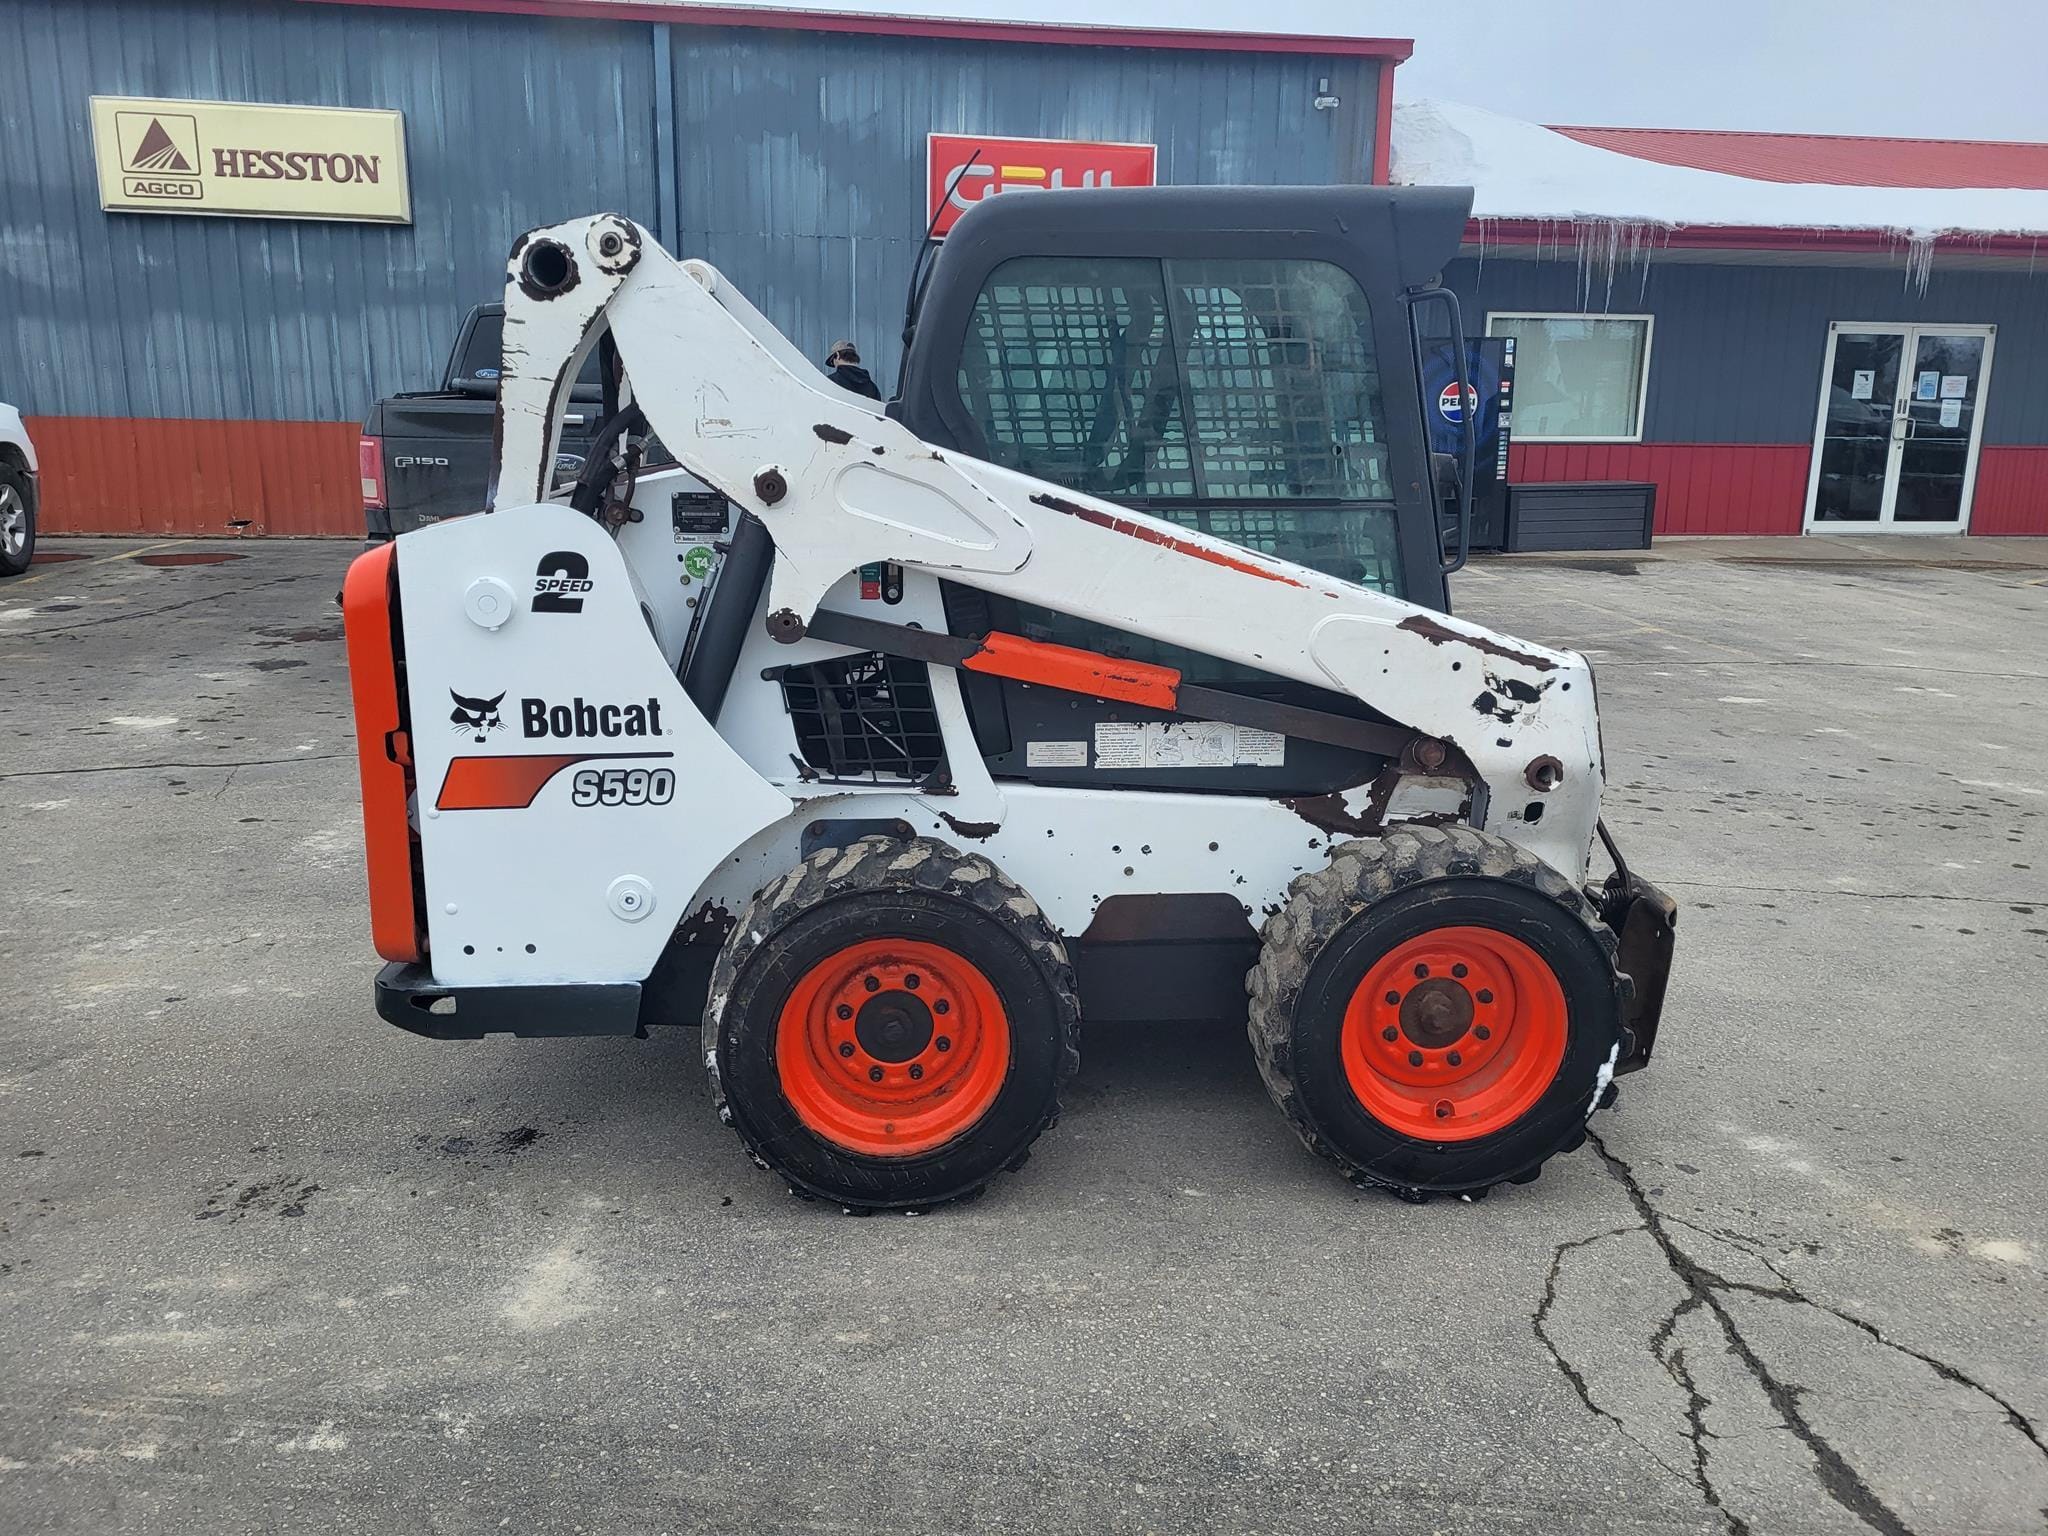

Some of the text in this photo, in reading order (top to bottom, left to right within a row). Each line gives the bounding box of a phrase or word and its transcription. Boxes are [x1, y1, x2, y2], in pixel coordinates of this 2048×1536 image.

[212, 148, 379, 184] HESSTON
[132, 181, 194, 196] AGCO
[1441, 397, 1475, 407] PEI
[693, 557, 709, 569] T4
[531, 550, 590, 613] 2
[534, 579, 593, 593] SPEED
[521, 697, 663, 738] Bobcat
[571, 768, 676, 807] S590
